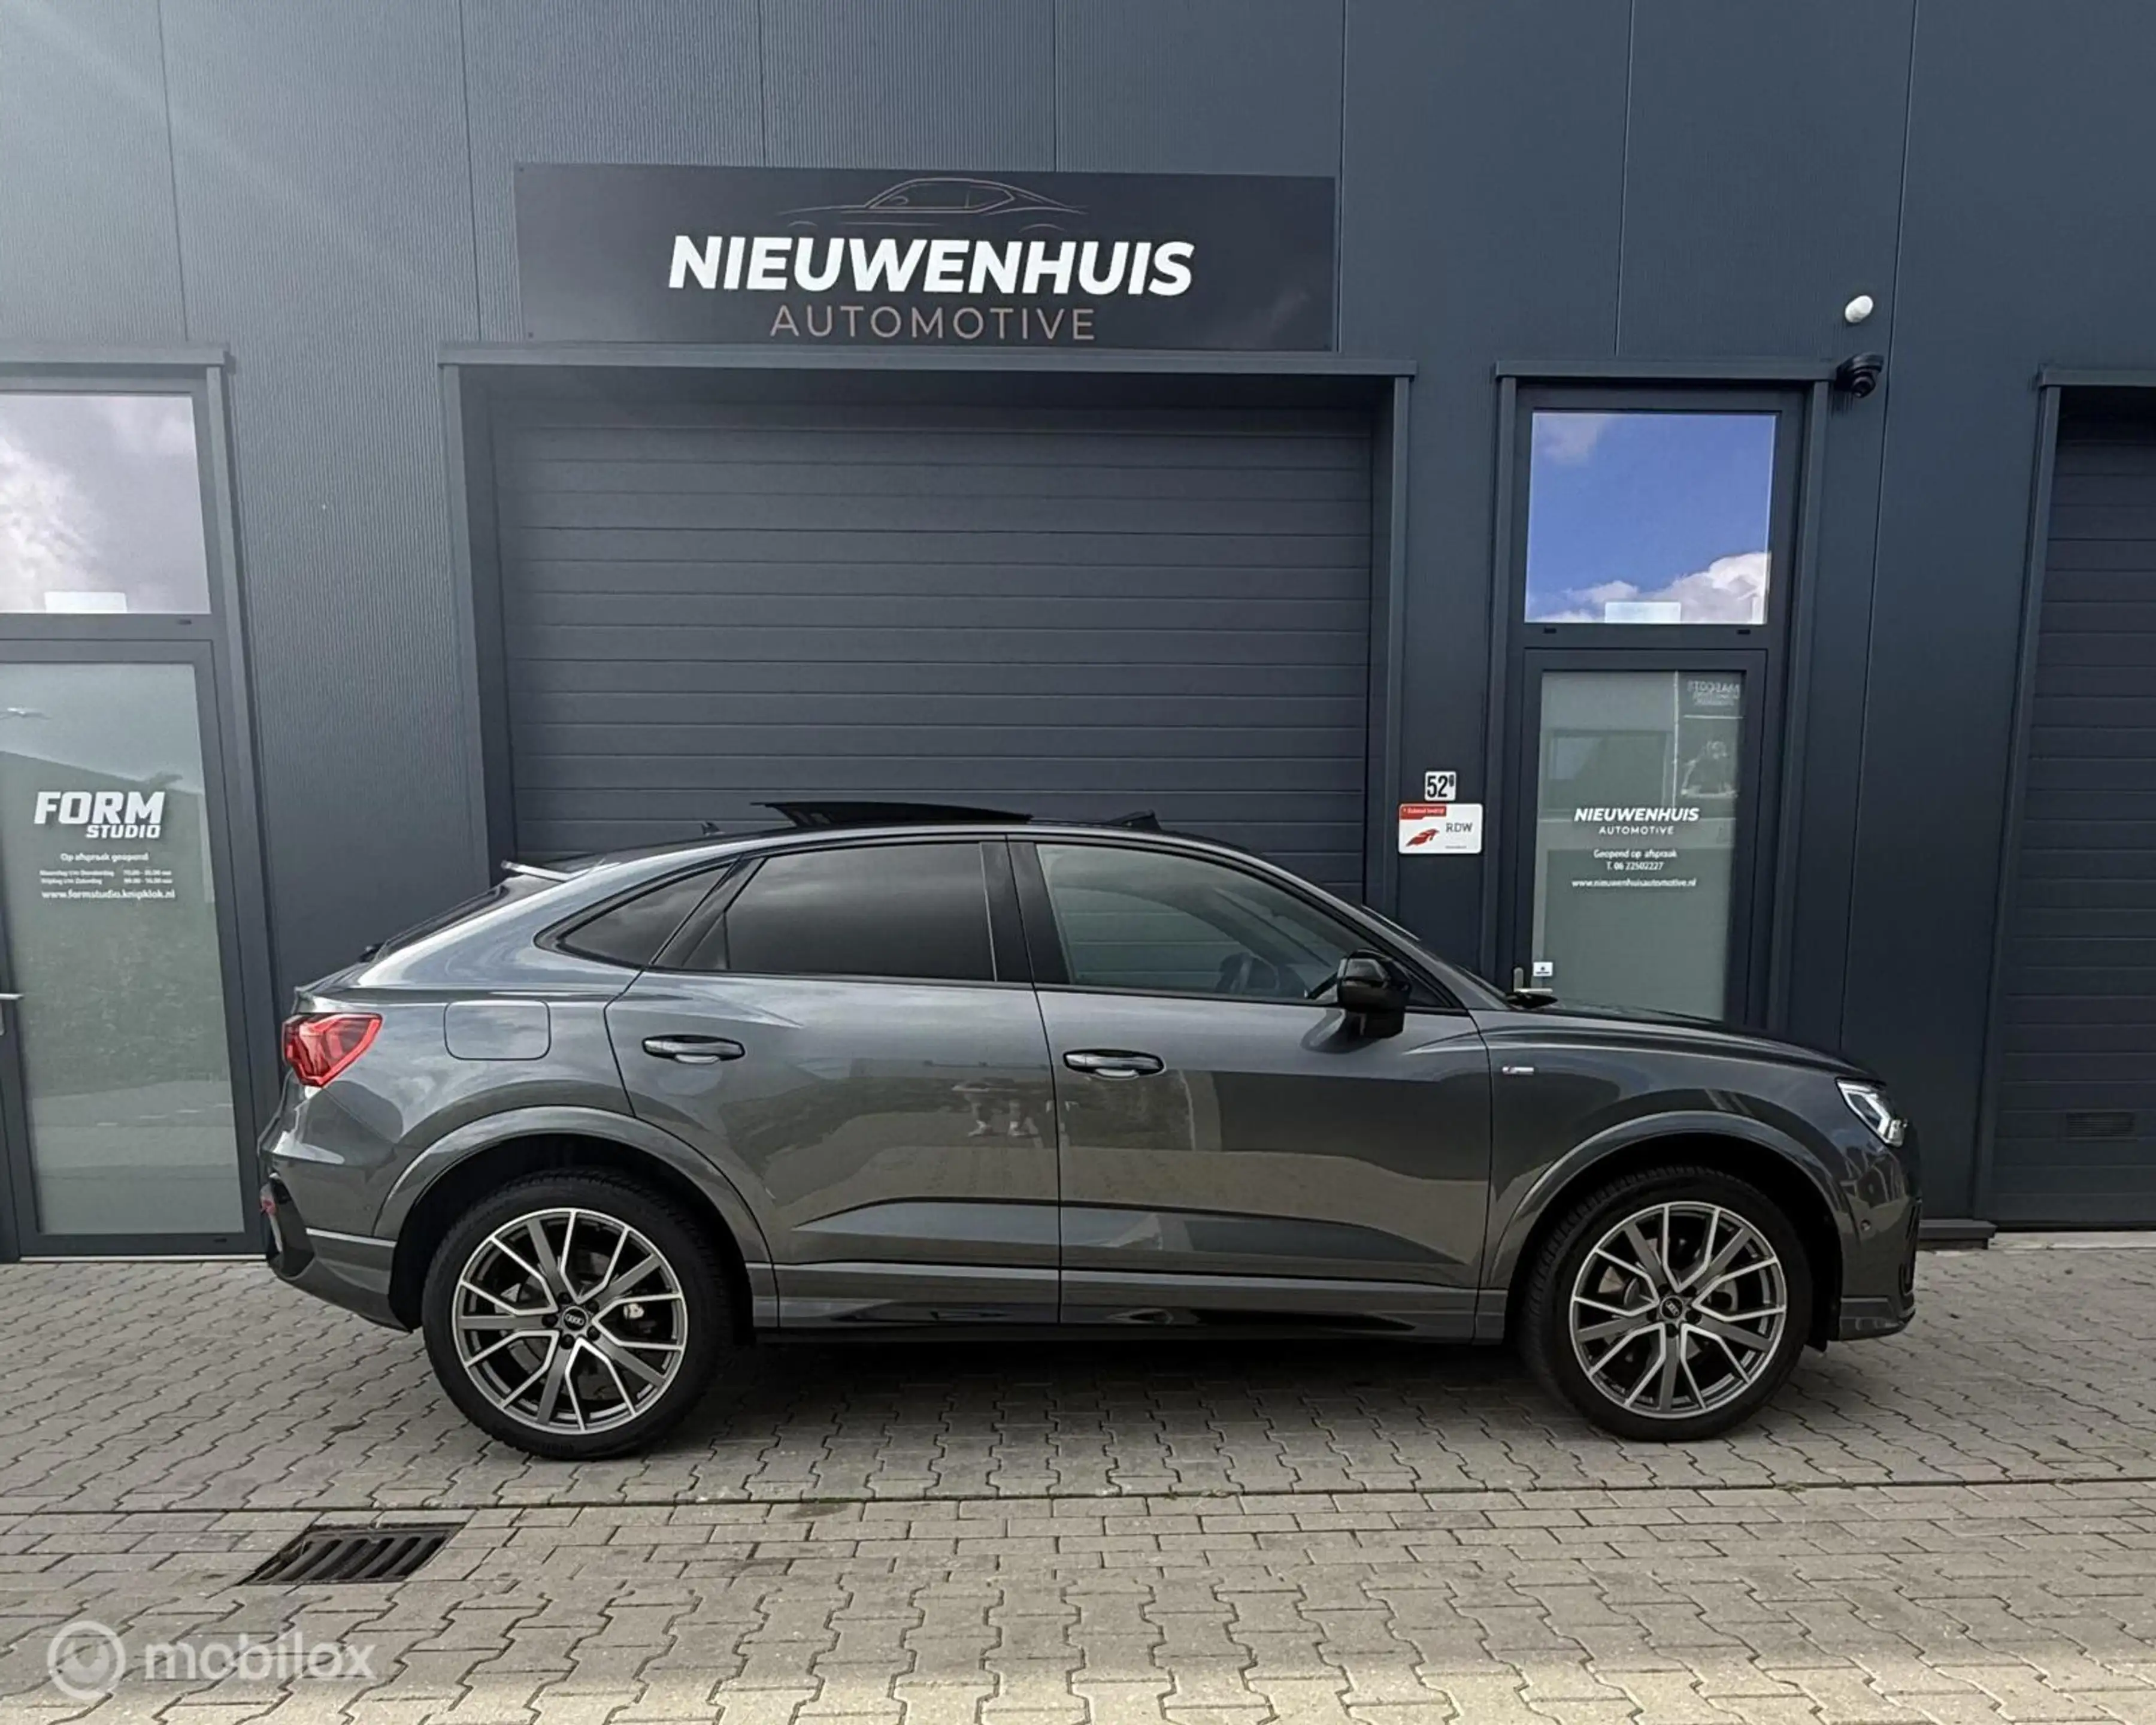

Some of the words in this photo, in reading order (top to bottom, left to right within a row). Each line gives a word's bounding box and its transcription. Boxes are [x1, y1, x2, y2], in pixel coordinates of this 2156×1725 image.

[668, 235, 1195, 296] NIEUWENHUIS
[770, 305, 1095, 341] AUTOMOTIVE
[34, 791, 165, 824] FORM
[1573, 807, 1700, 822] NIEUWENHUIS
[85, 824, 161, 839] STUDIO
[1446, 822, 1473, 833] RDW
[1598, 826, 1675, 836] AUTOMOTIVE
